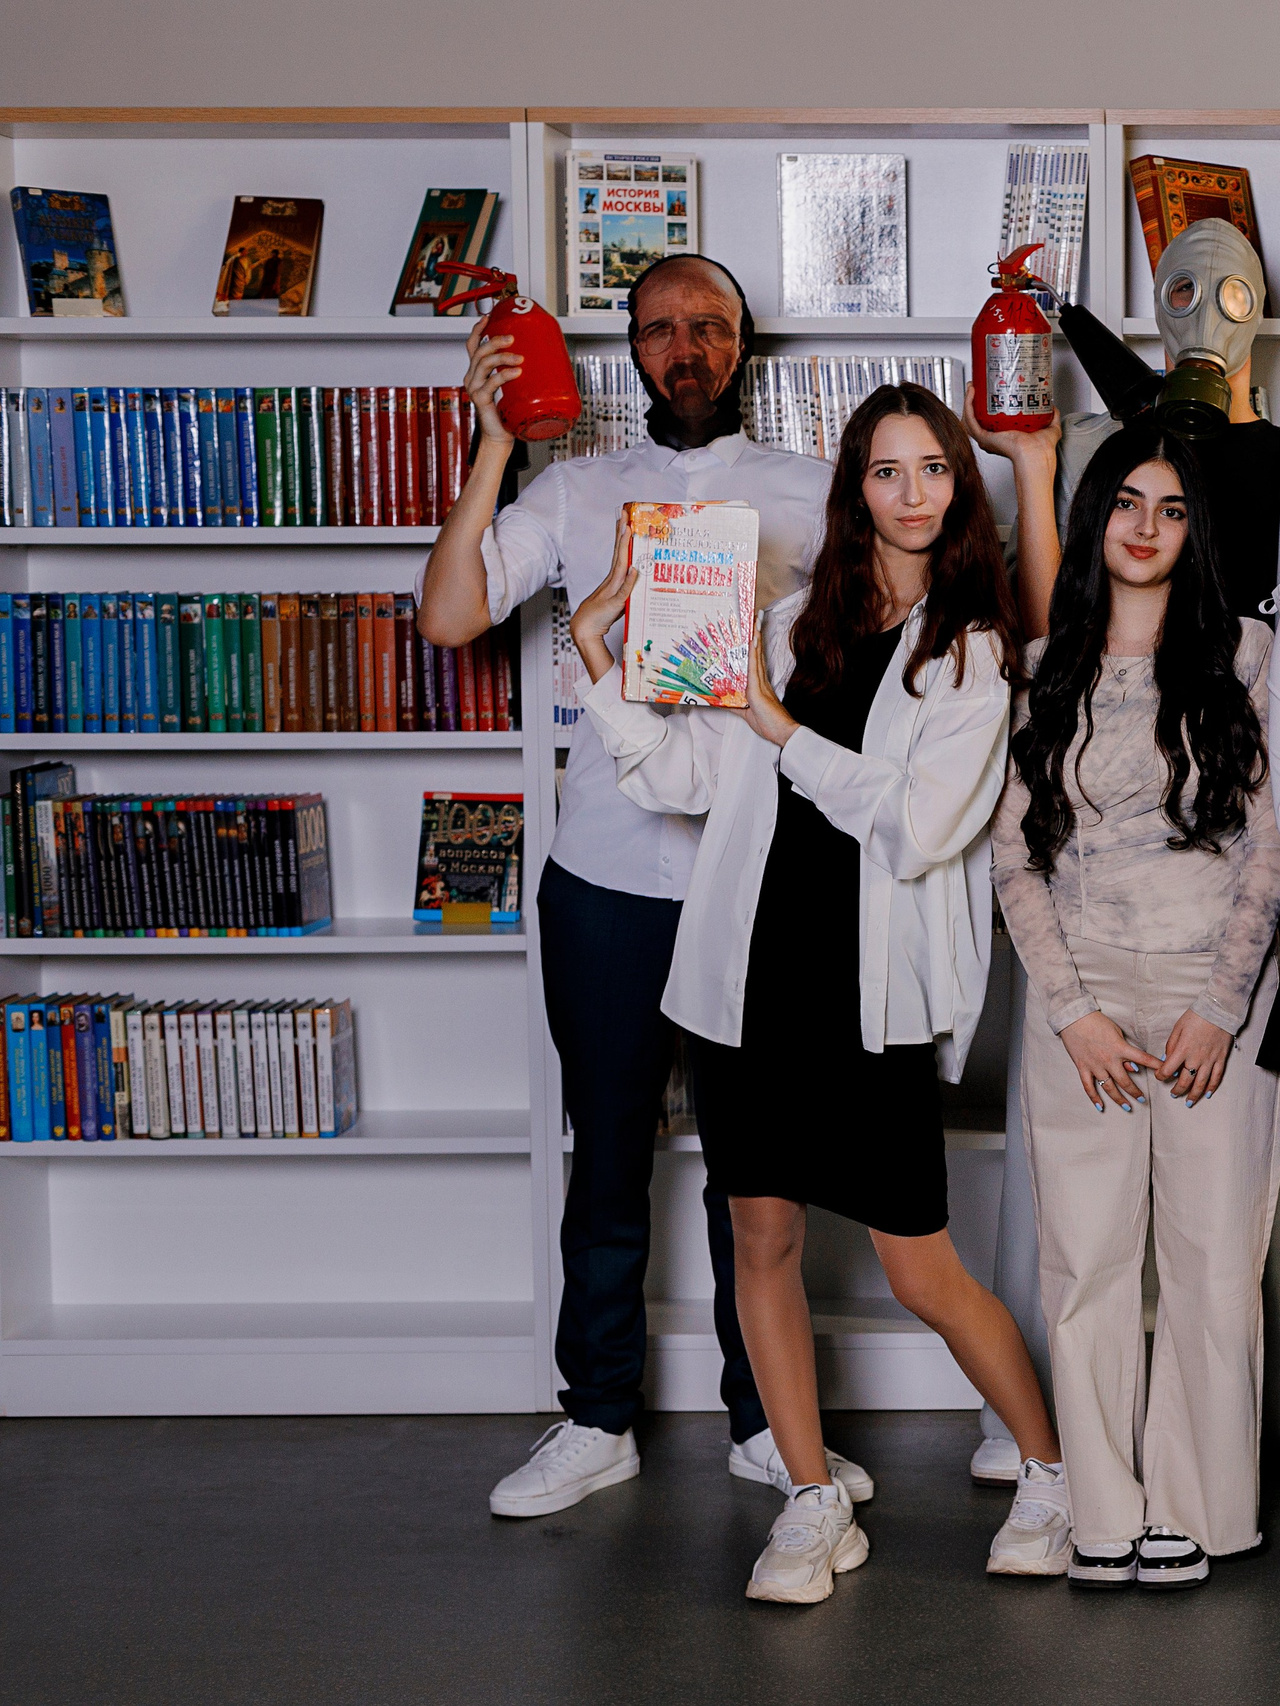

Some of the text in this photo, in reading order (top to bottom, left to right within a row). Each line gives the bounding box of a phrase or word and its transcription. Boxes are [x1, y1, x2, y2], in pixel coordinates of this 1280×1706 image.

[607, 189, 660, 198] ИСТОРИЯ
[602, 201, 664, 213] МОСКВЫ
[512, 297, 534, 314] 9
[656, 526, 710, 537] БОЛЬШАЯ
[654, 548, 733, 565] НАЧАЛЬНОЙ
[654, 563, 733, 587] ШКОЛЫ
[440, 849, 505, 861] вопросов
[438, 862, 503, 874] о Москве
